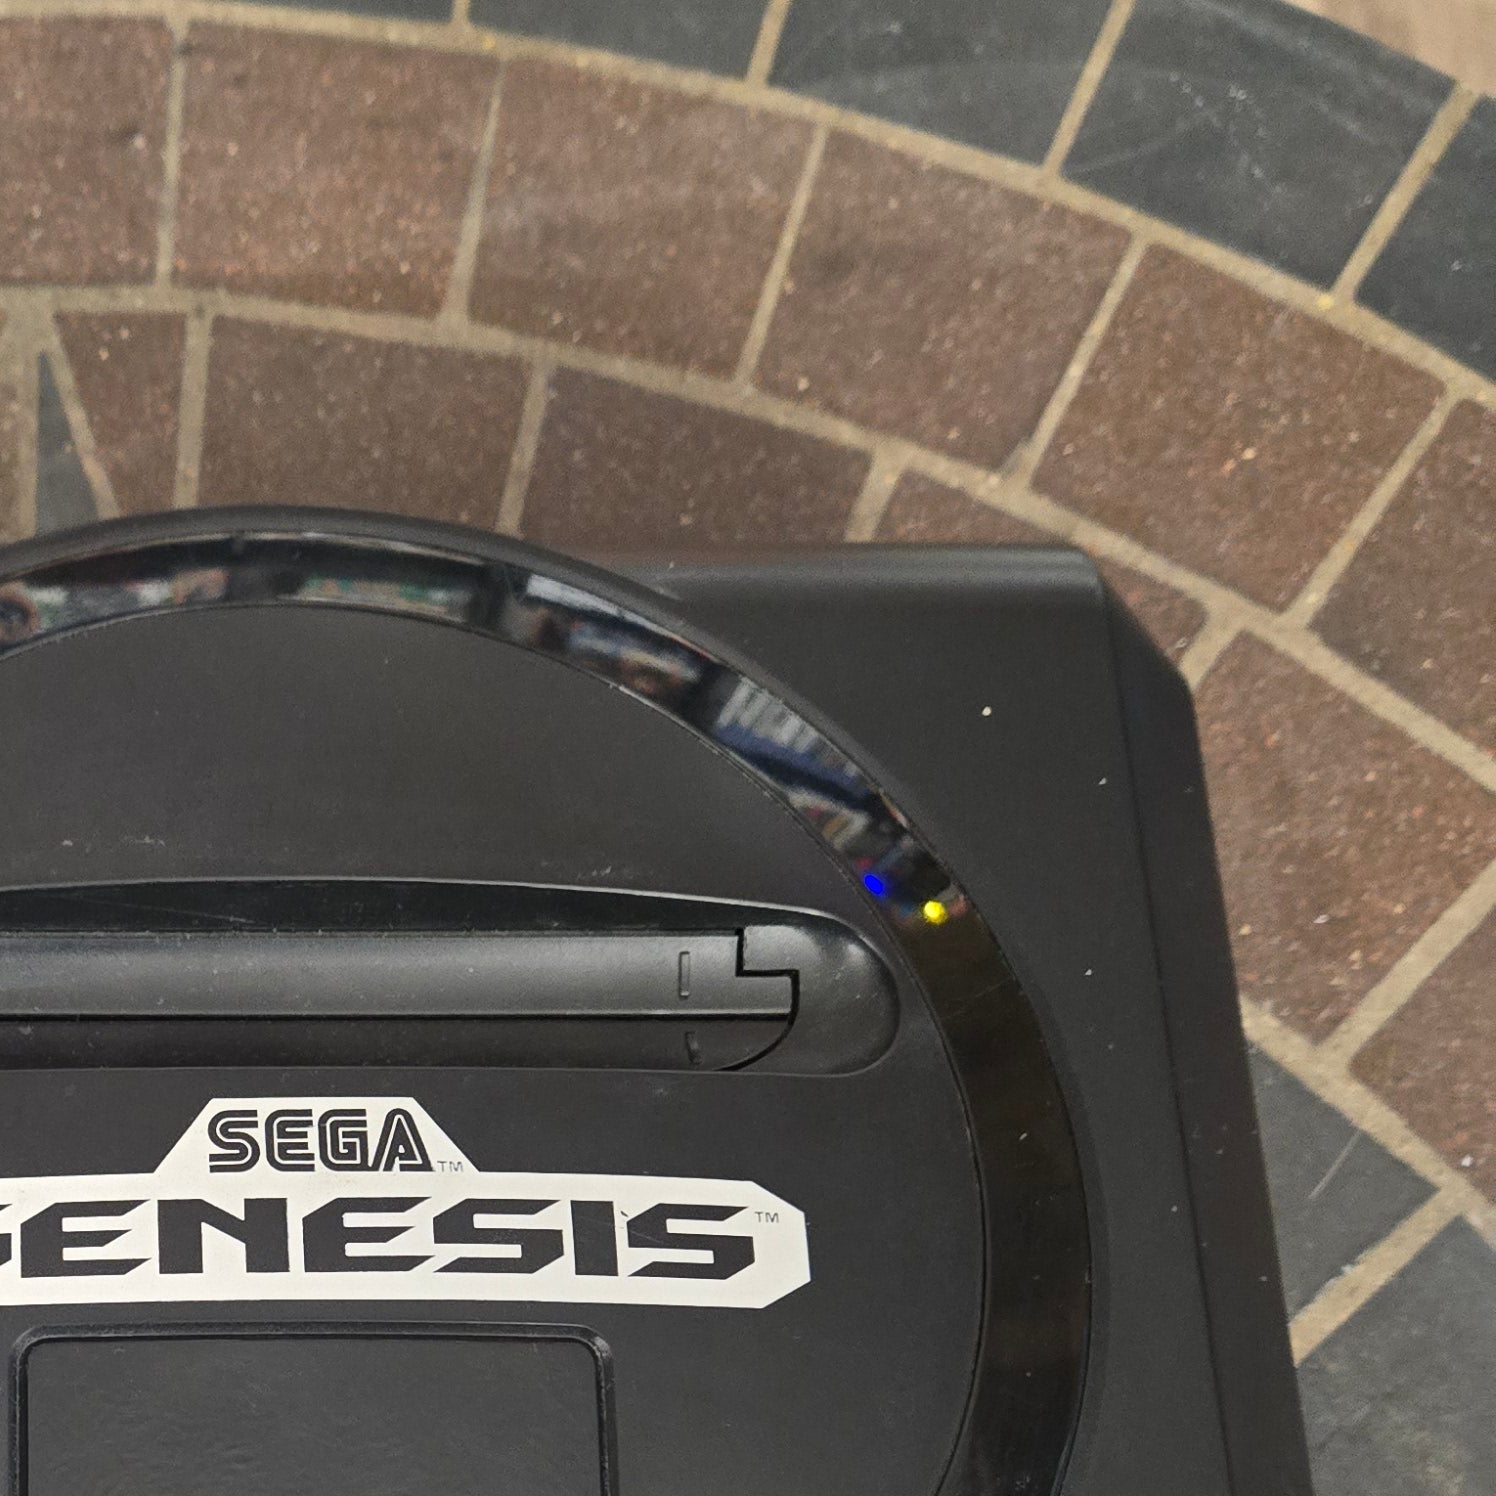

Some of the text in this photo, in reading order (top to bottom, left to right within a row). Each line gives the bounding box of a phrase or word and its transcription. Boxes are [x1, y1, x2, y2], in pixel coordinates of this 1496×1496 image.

[207, 1108, 464, 1173] SEGA TM
[754, 1210, 780, 1224] TM
